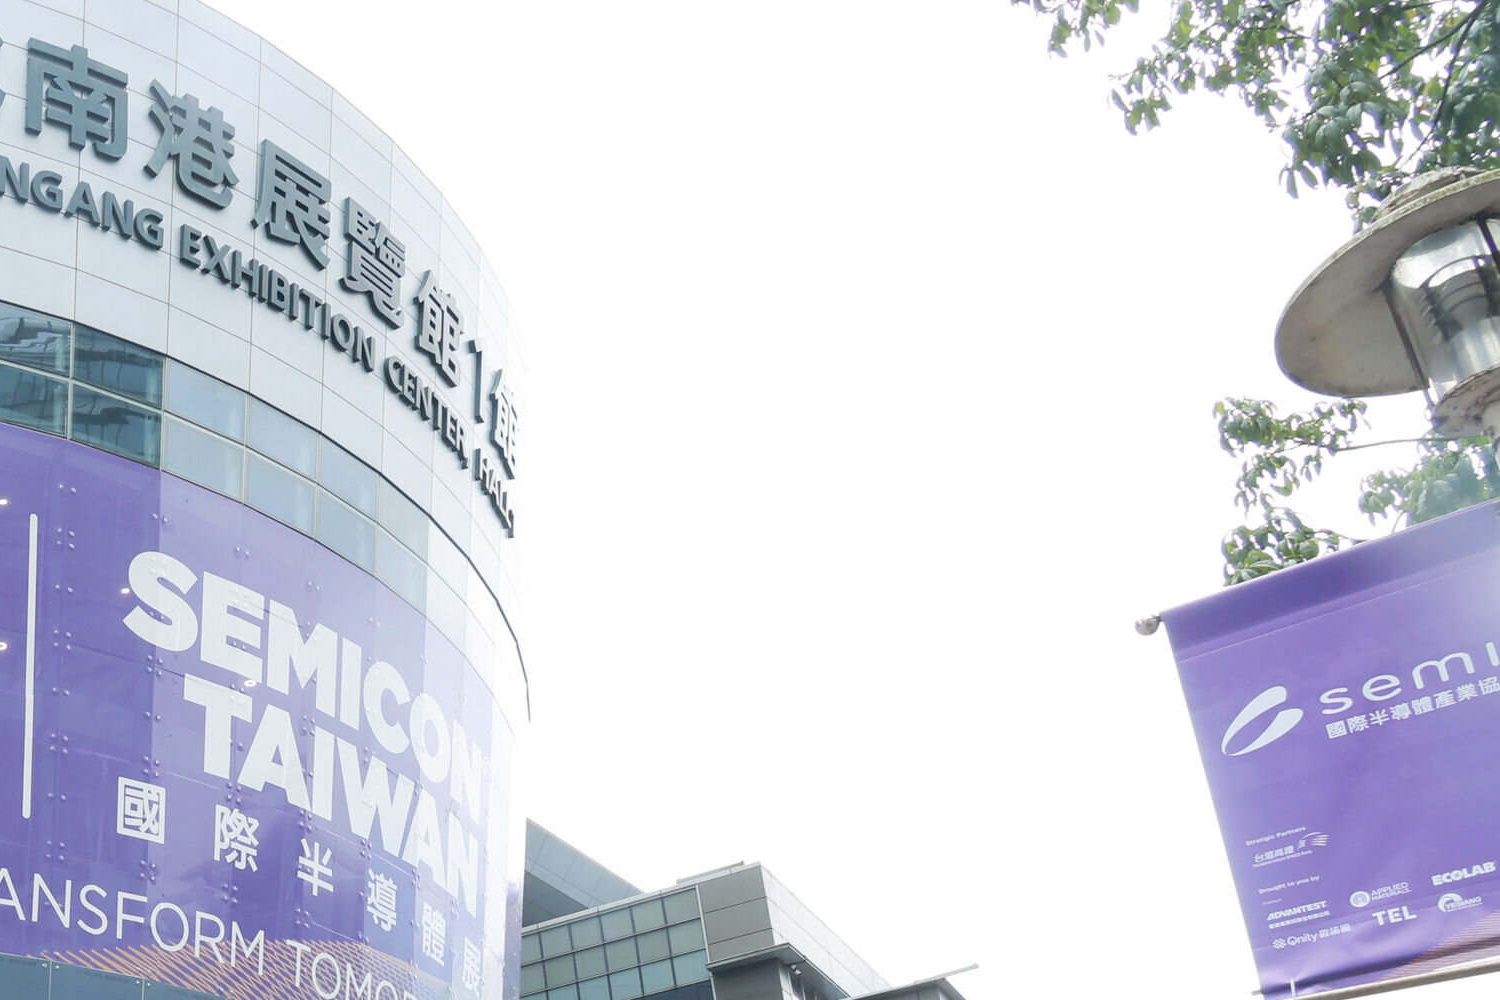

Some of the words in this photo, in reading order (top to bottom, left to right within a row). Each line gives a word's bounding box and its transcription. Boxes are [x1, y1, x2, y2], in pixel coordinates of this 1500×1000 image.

[180, 223, 376, 372] EXHIBITION
[122, 551, 482, 827] SEMICON
[183, 673, 480, 919] TAIWAN
[116, 776, 483, 999] 國際半導體展
[1267, 900, 1328, 921] ADVANTEST
[1371, 881, 1409, 896] APPLIED
[1372, 905, 1418, 926] TEL
[1431, 861, 1496, 886] ECOLAB
